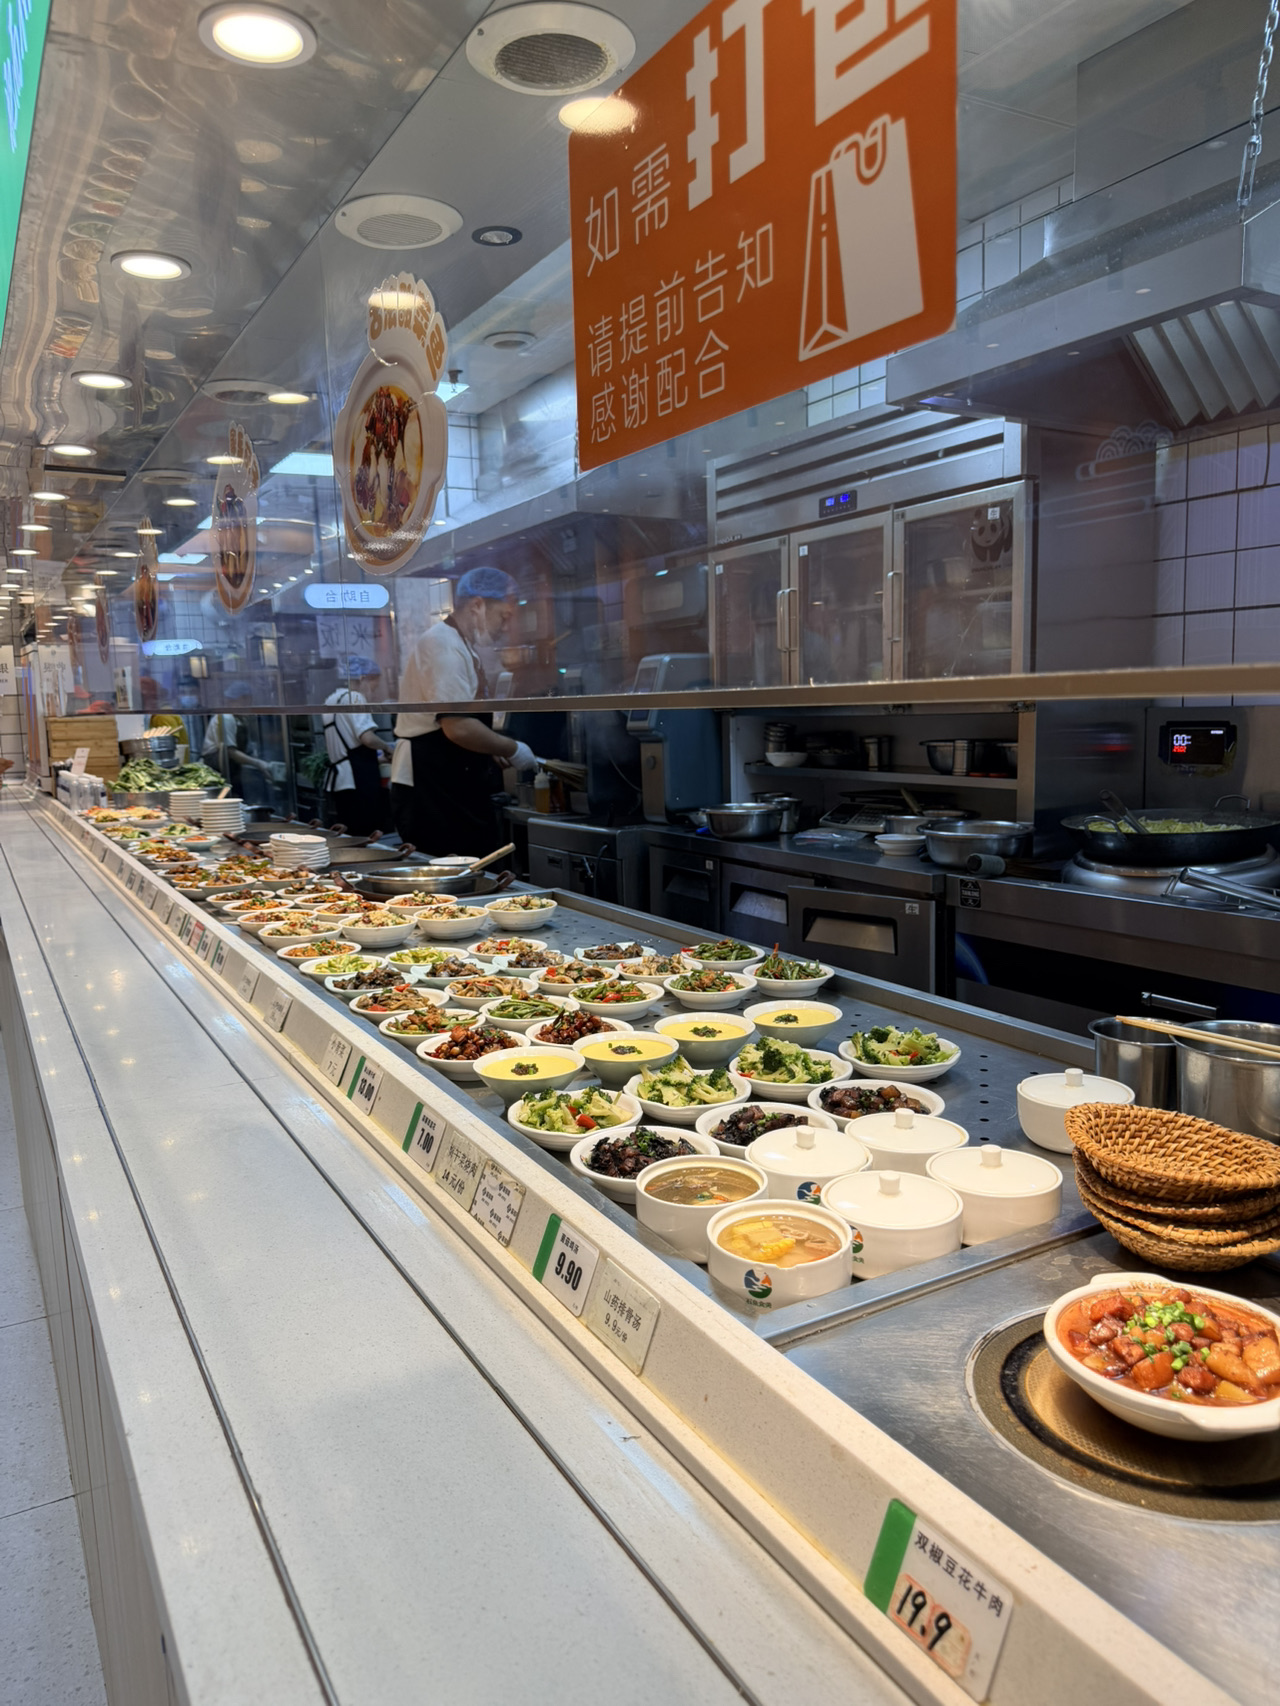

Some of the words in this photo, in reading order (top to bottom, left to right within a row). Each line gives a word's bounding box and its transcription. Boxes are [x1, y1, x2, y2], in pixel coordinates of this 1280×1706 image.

[585, 143, 671, 277] 如需
[587, 223, 774, 377] 请提前告知
[590, 330, 729, 443] 感谢配合
[416, 1127, 435, 1155] 7.00
[554, 1251, 583, 1292] 9.90
[603, 1288, 643, 1332] 山药排骨汤
[914, 1530, 1004, 1618] 双椒豆花牛肉
[896, 1584, 953, 1652] 19.9
